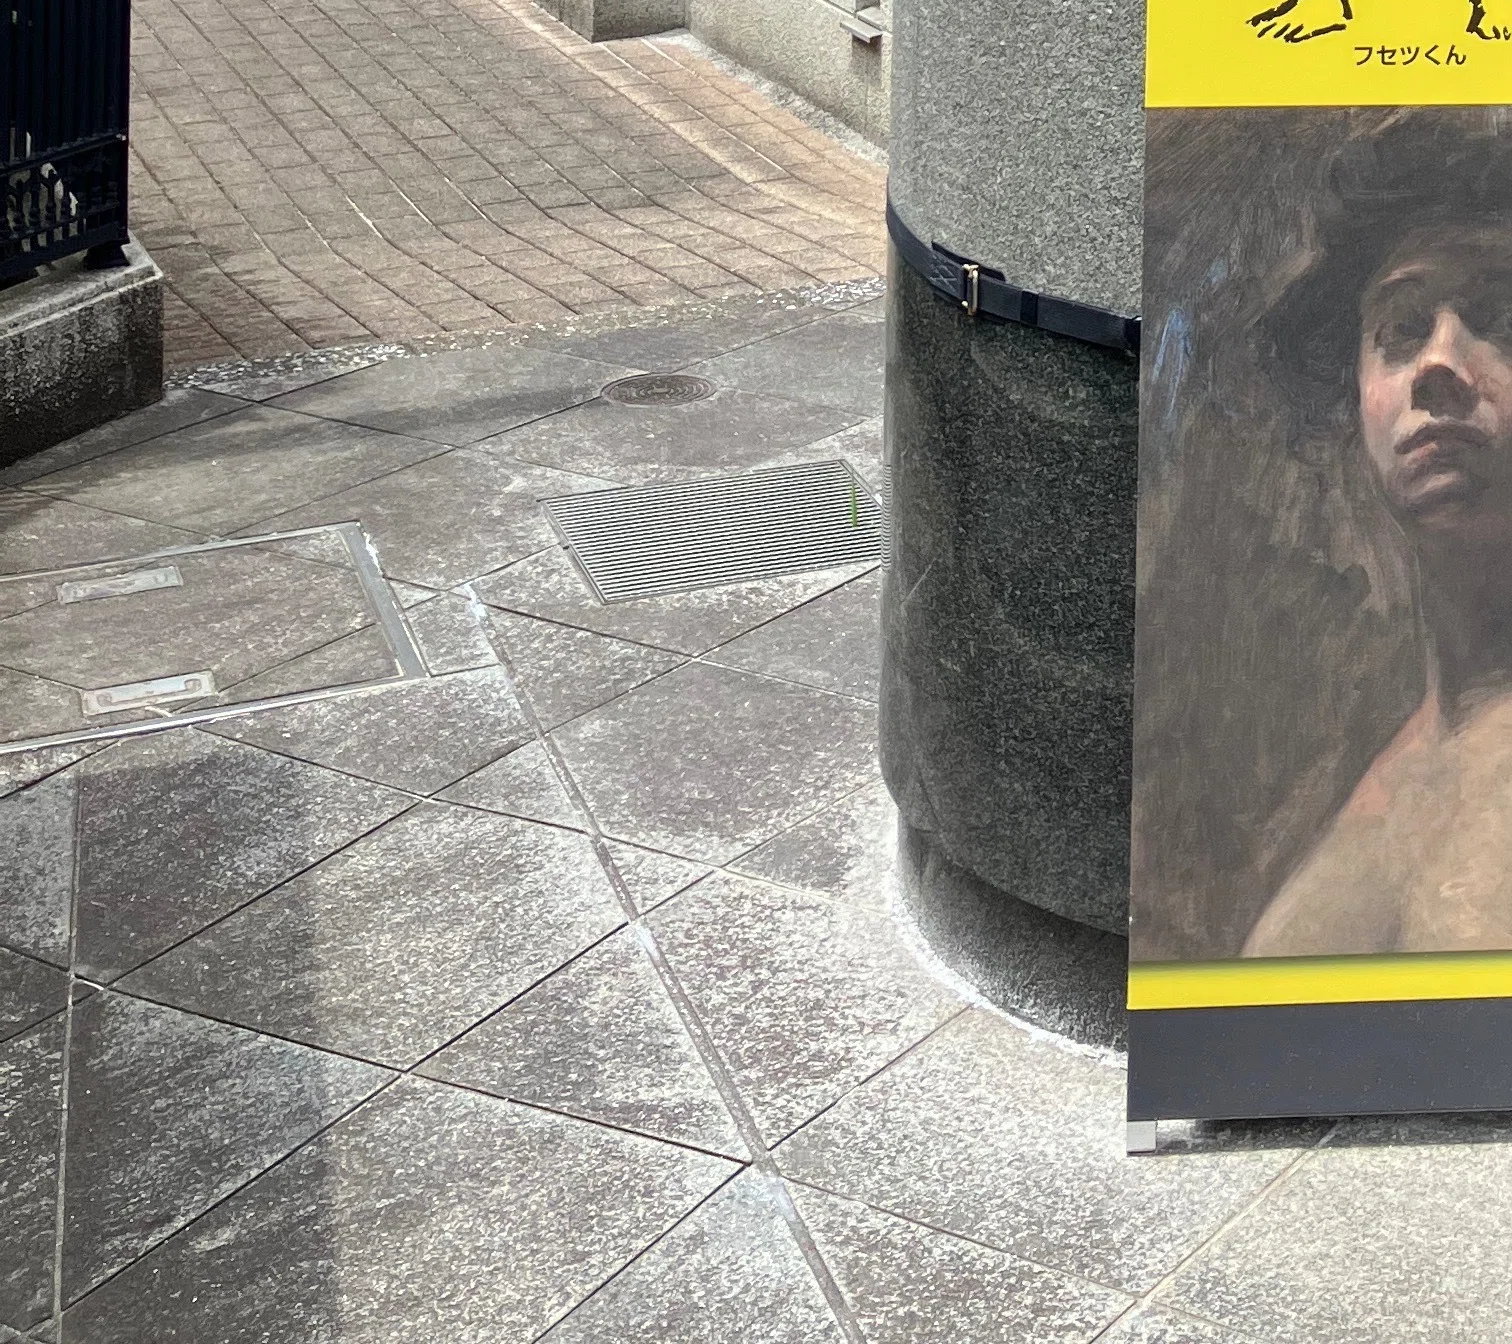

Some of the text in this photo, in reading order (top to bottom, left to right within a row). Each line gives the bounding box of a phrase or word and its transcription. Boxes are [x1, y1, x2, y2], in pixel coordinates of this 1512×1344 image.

[1354, 45, 1468, 68] フセツくん
